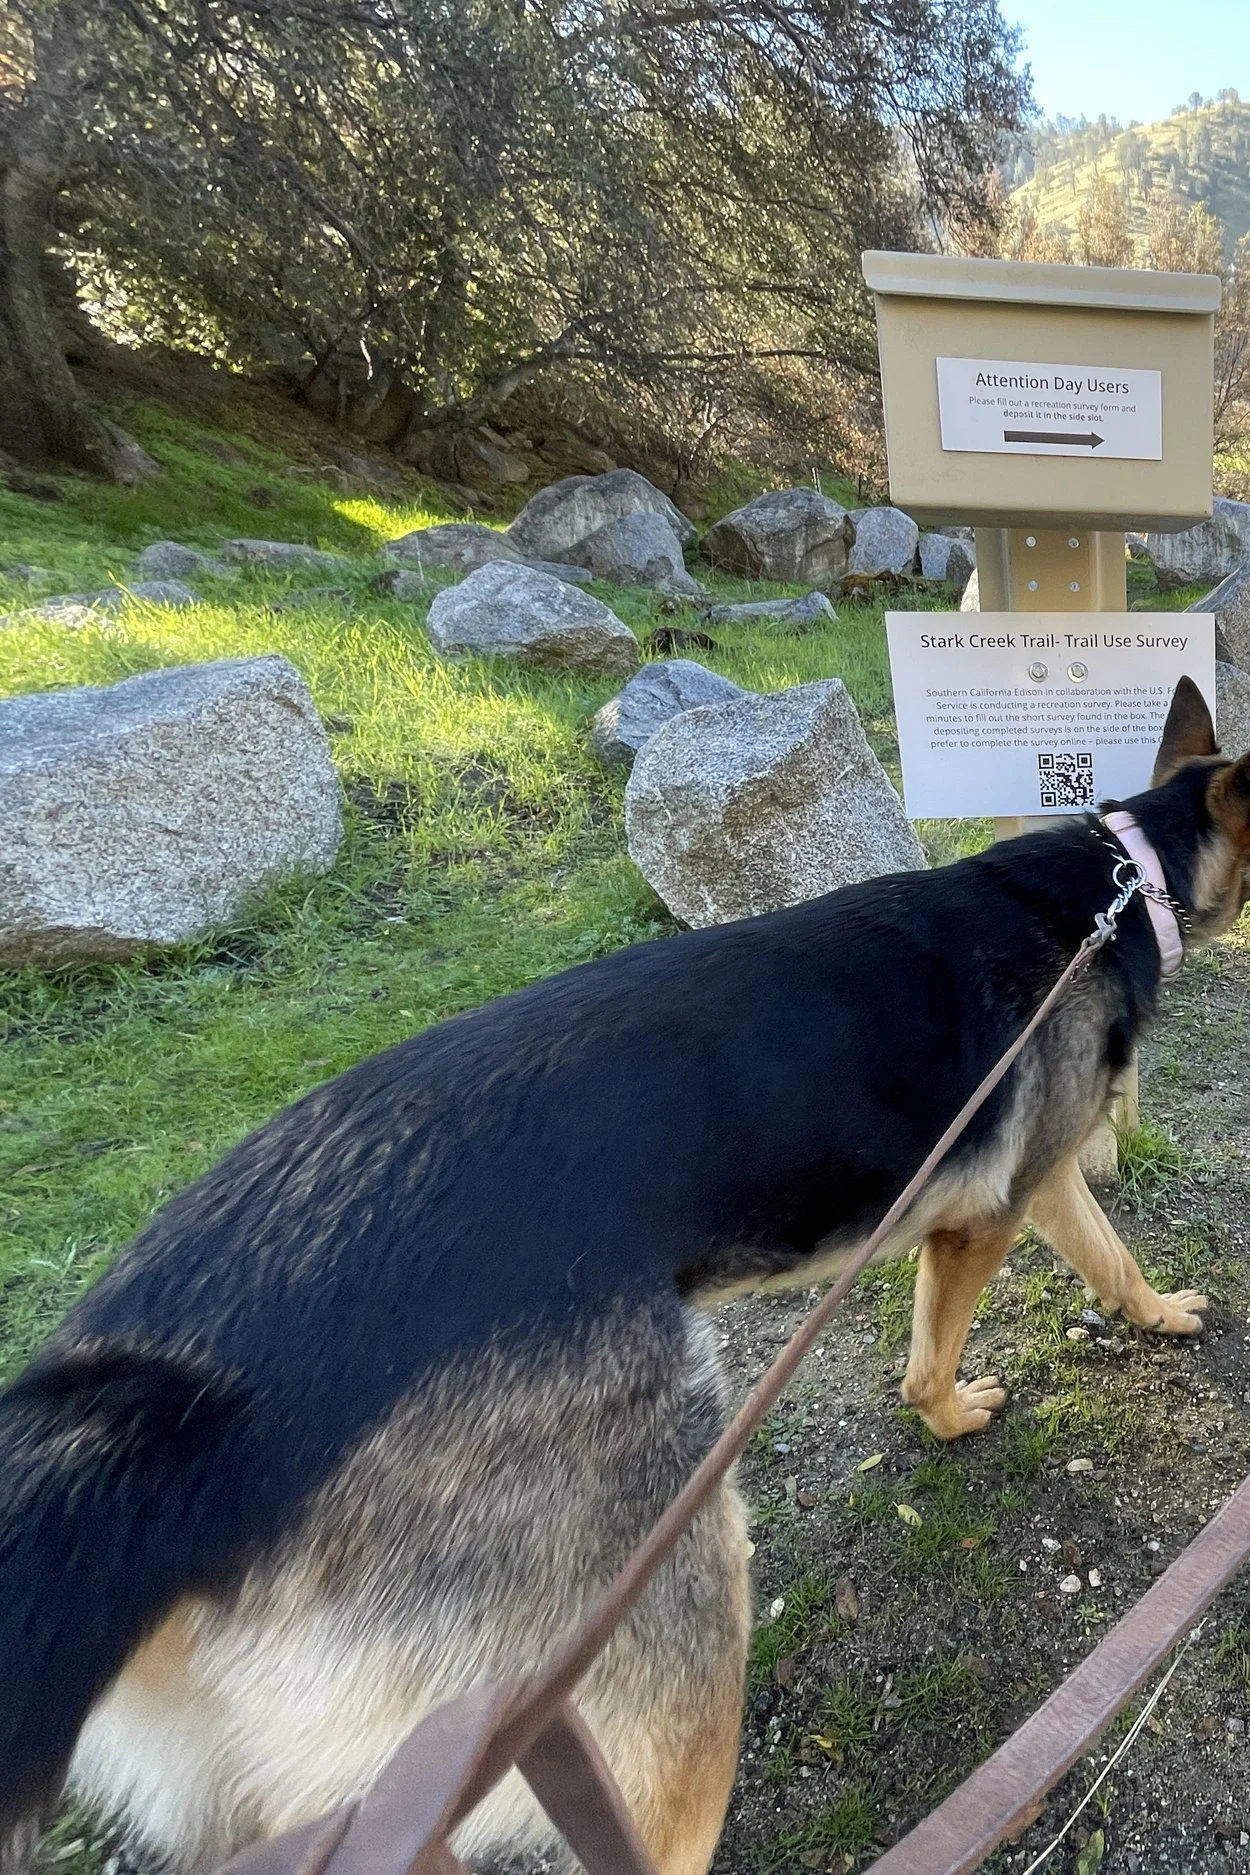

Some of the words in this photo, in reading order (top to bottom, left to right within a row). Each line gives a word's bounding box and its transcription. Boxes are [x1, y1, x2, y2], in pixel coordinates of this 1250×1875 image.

[976, 372, 1049, 390] Attention
[1055, 376, 1082, 395] Day
[1088, 378, 1129, 394] Users
[969, 396, 995, 405] Please
[997, 398, 1007, 406] fill
[1031, 400, 1071, 409] recreation
[1073, 402, 1098, 412] survey
[1101, 403, 1119, 412] form
[1122, 404, 1136, 413] and
[1004, 409, 1033, 420] deposit
[1054, 411, 1067, 420] the
[1069, 412, 1085, 421] side
[1087, 413, 1104, 422] slot.
[920, 634, 964, 648] Stark
[969, 634, 1015, 648] Creek
[1020, 634, 1060, 648] Trail-
[1064, 634, 1098, 648] Trail
[1104, 635, 1131, 648] Use
[1136, 635, 1188, 651] Survey
[970, 688, 1012, 696] California
[1056, 688, 1111, 696] collaboration
[980, 701, 1028, 711] conducting
[1037, 700, 1081, 709] recreation
[1083, 701, 1112, 710] survey.
[976, 714, 986, 722] fill
[1022, 713, 1044, 721] short
[1047, 713, 1075, 722] survey
[1077, 712, 1102, 721] found
[934, 727, 980, 736] depositing
[982, 726, 1027, 735] completed
[1030, 726, 1062, 735] surveys
[1103, 724, 1120, 732] side
[931, 740, 957, 749] prefer
[972, 739, 1012, 748] complete
[1014, 739, 1028, 747] the
[1031, 738, 1058, 747] survey
[1061, 737, 1086, 746] online
[1096, 737, 1122, 746] please
